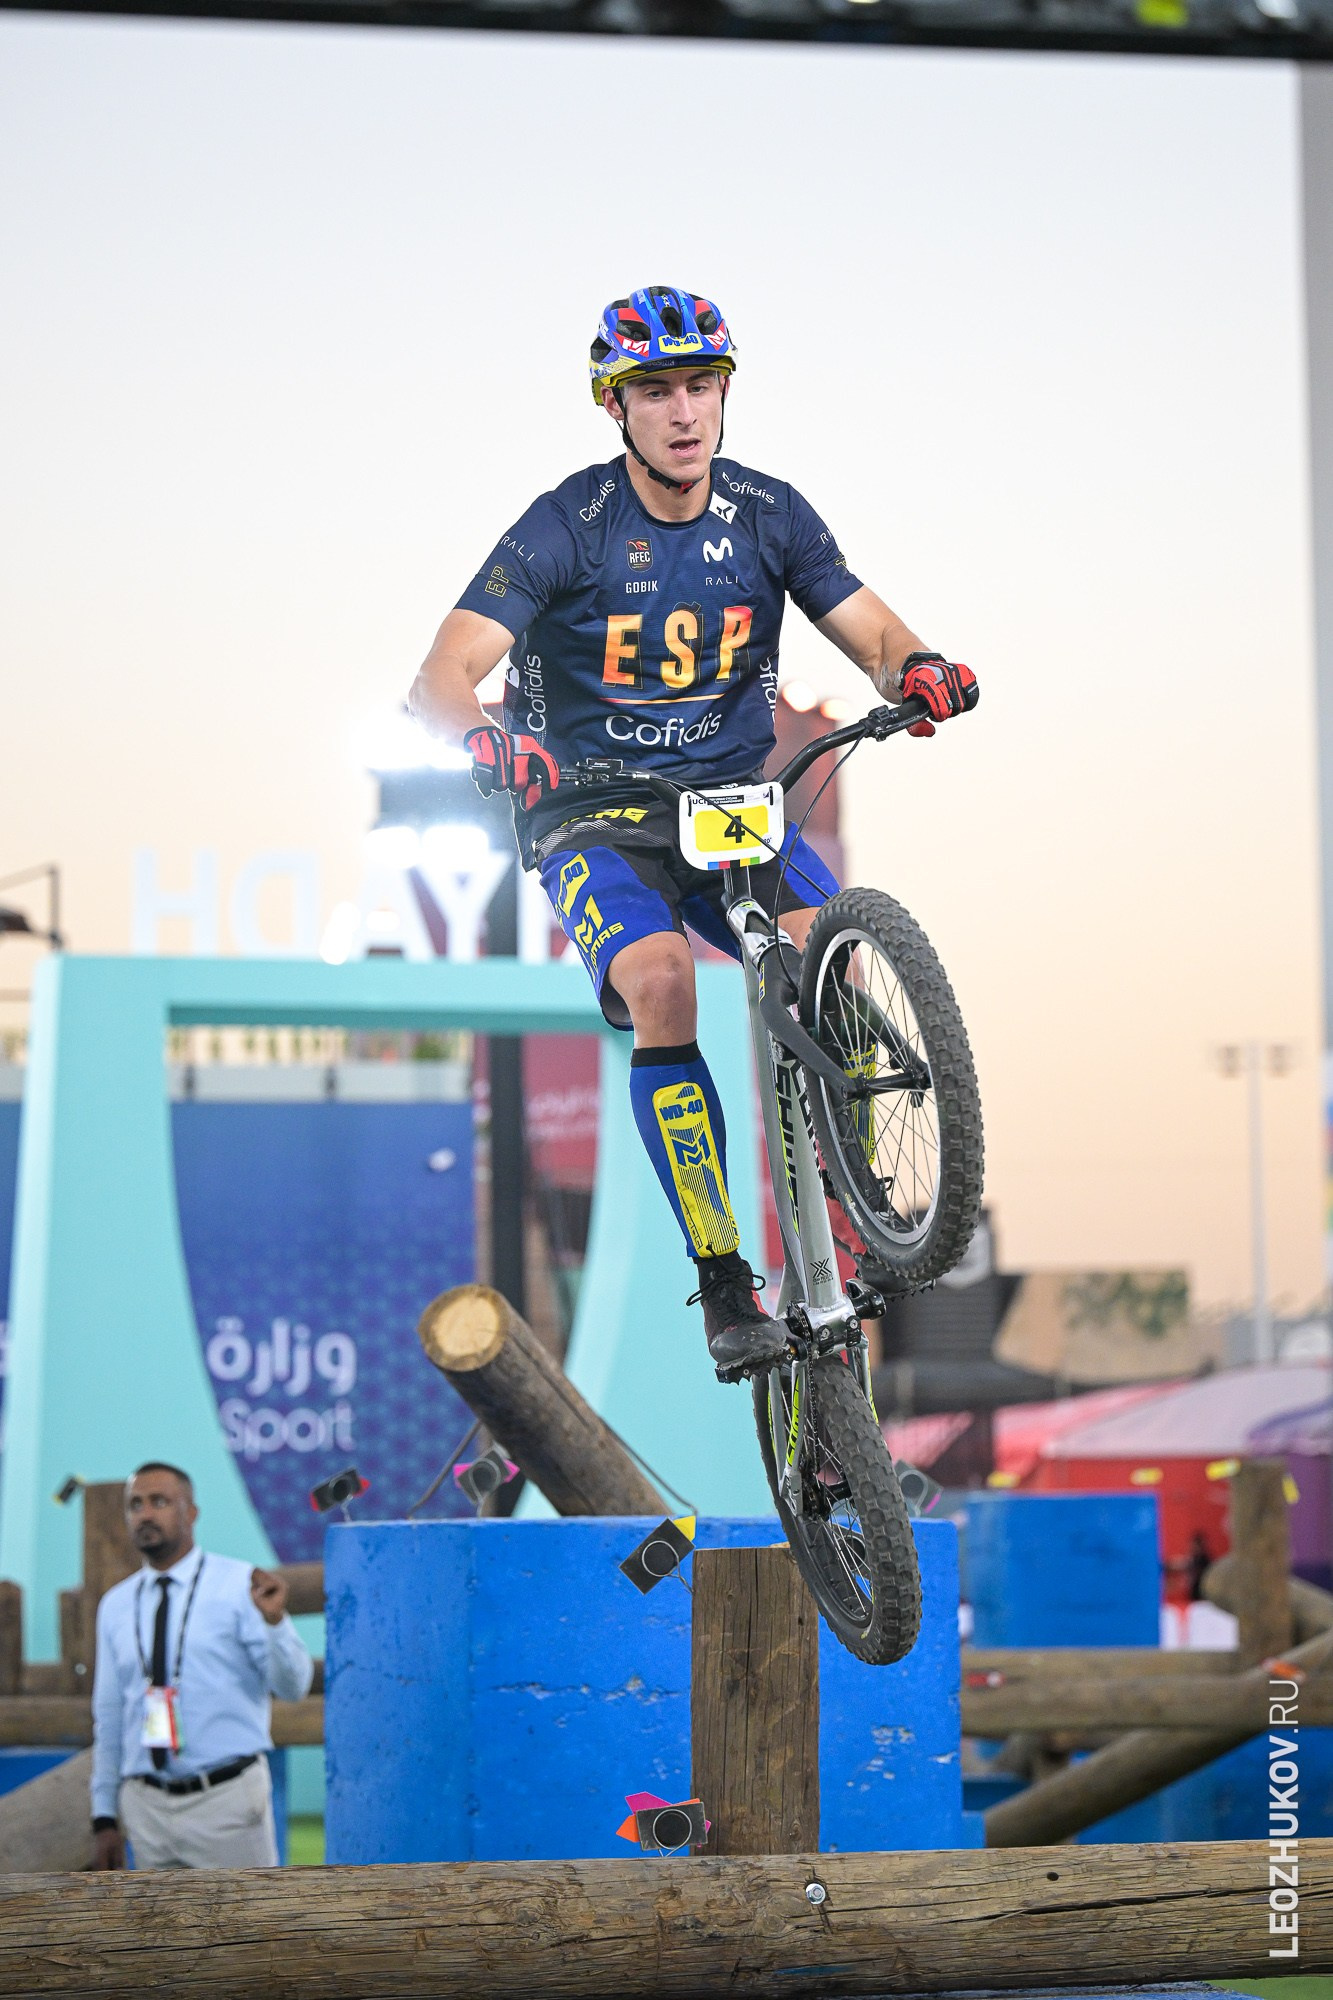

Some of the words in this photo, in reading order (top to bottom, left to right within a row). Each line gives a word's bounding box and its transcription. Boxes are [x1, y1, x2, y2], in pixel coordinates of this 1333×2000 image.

[579, 479, 616, 522] Cofidis
[500, 535, 535, 562] RALI
[629, 551, 651, 564] RFEC
[625, 580, 659, 594] GOBIK
[705, 575, 739, 586] RALI
[602, 605, 753, 690] ESP
[526, 654, 547, 733] Cofidis
[605, 713, 722, 747] Cofidis
[724, 815, 746, 844] 4
[659, 1098, 704, 1122] WD-40
[205, 1315, 358, 1397] وزارة
[219, 1398, 356, 1463] Sport
